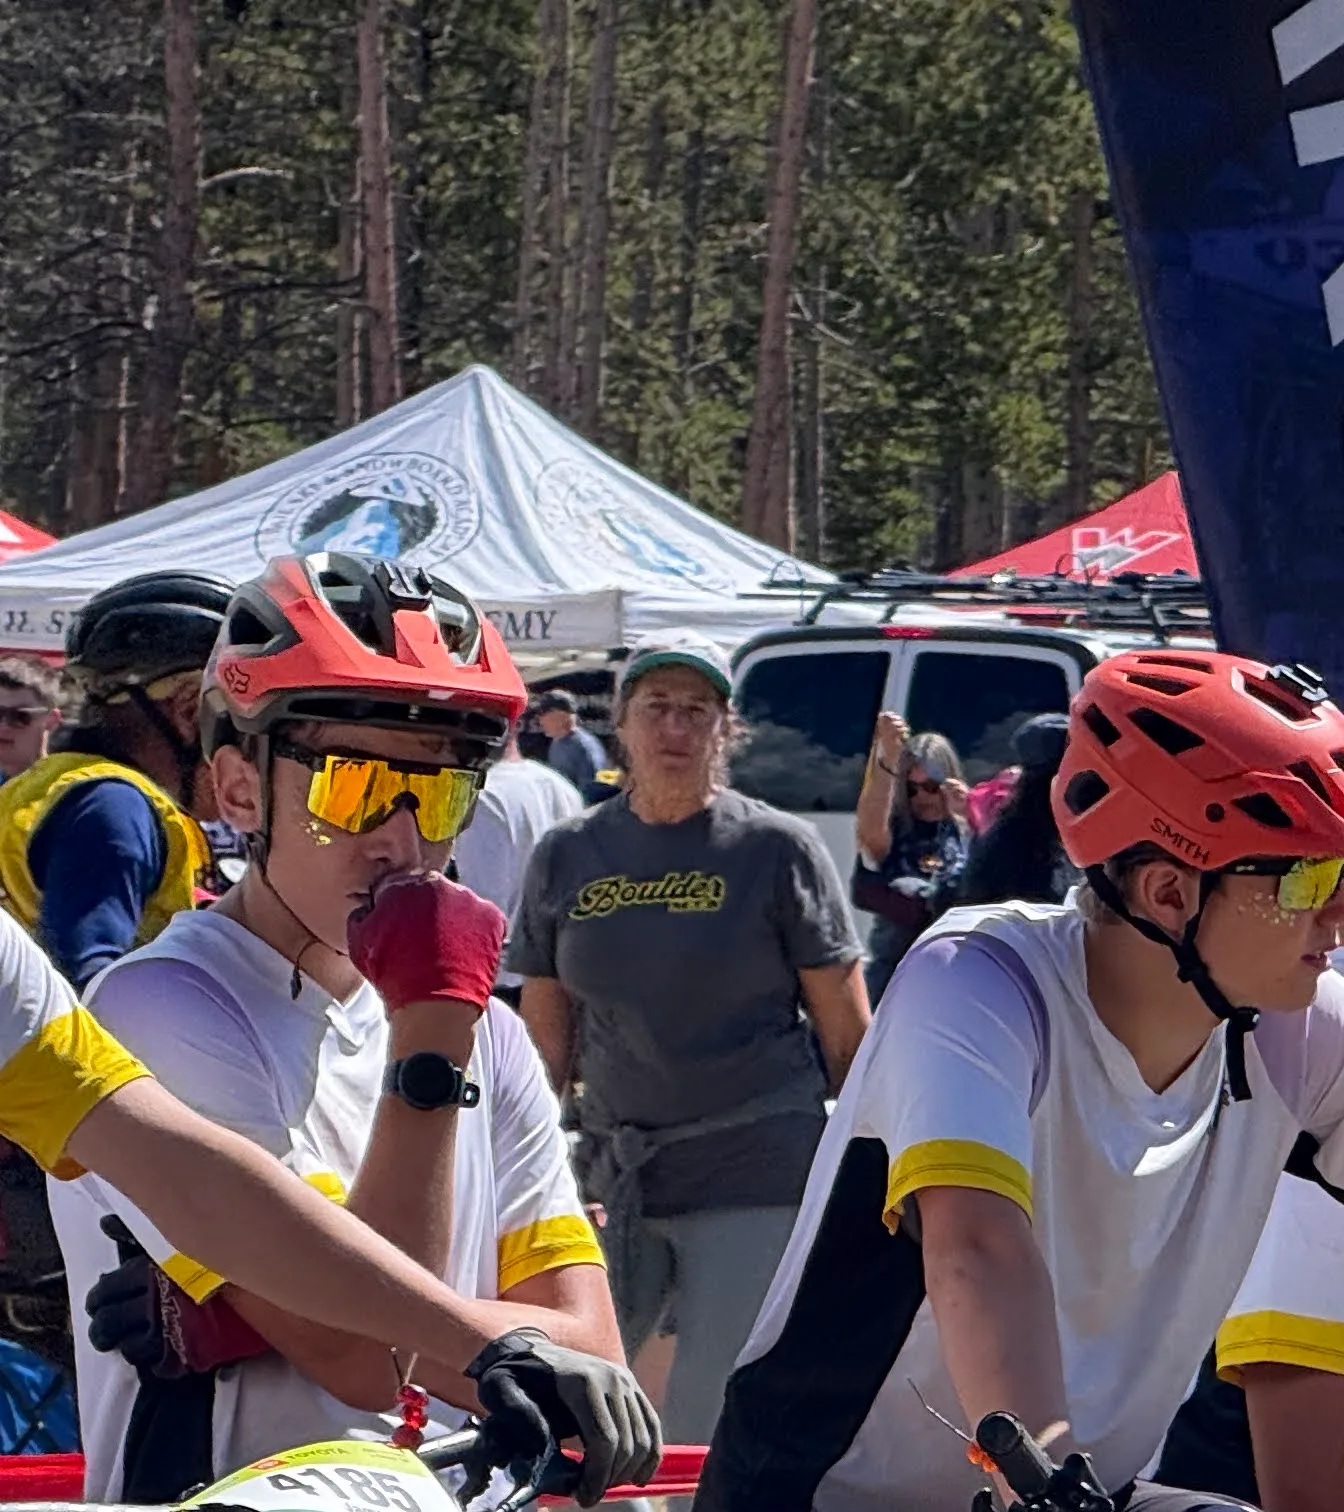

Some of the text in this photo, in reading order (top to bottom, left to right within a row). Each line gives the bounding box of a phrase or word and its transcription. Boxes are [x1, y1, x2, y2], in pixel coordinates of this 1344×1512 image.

[1150, 817, 1211, 866] SMITH
[568, 871, 726, 920] Boulder
[285, 1446, 351, 1461] TOYOTA
